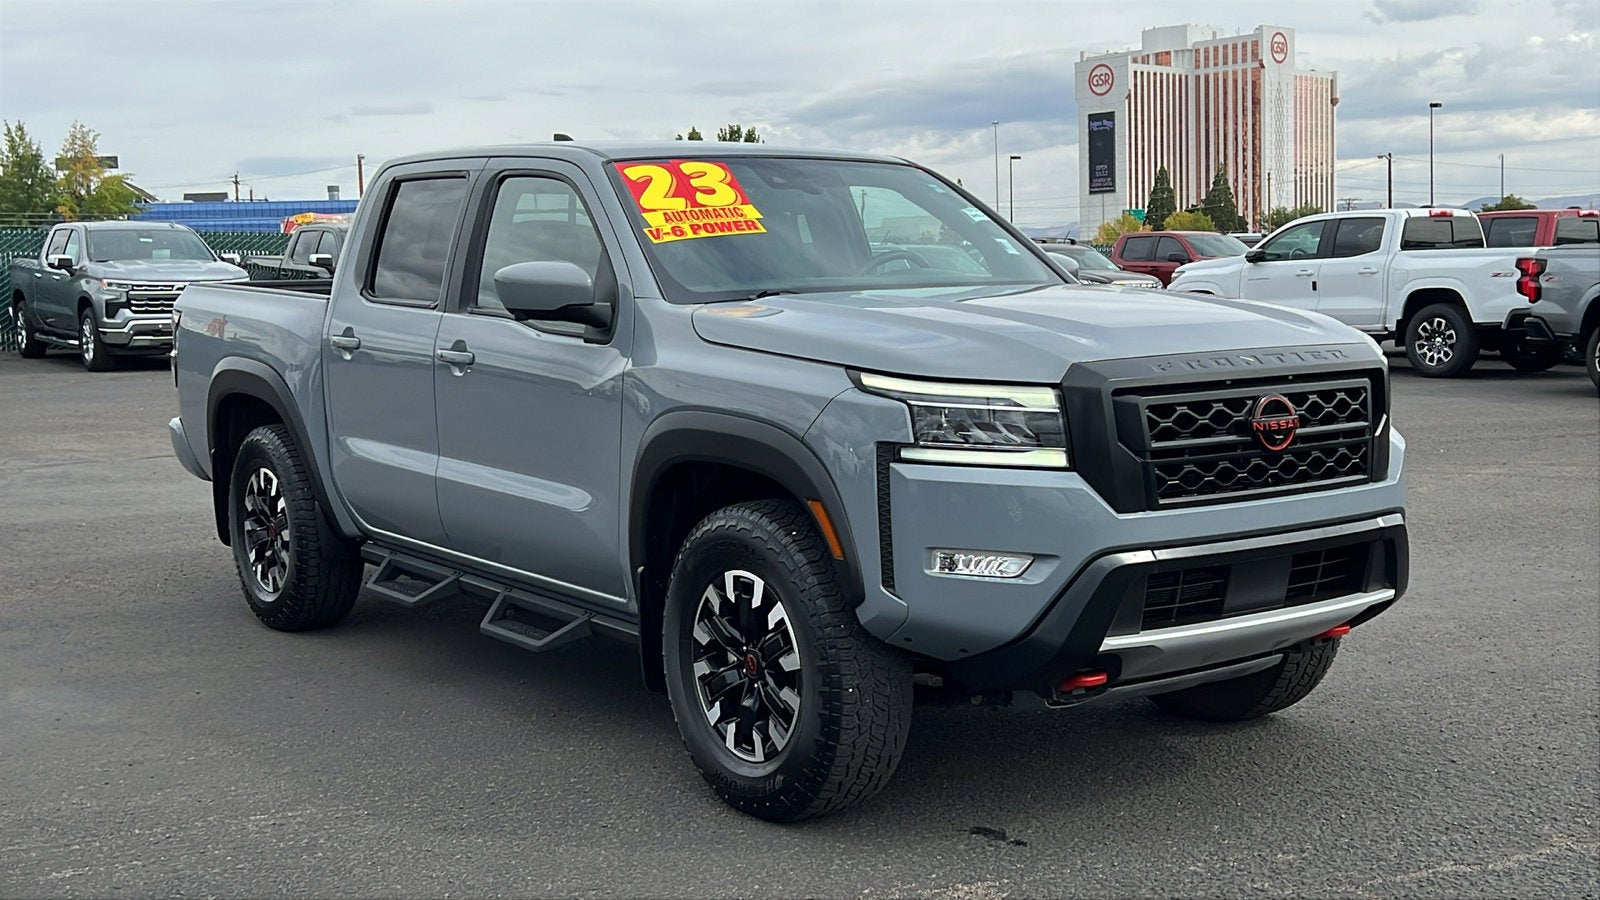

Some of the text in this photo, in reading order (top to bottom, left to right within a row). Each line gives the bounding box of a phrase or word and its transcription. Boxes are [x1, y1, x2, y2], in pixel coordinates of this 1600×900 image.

[1273, 41, 1286, 54] GSR
[1091, 72, 1111, 87] GSR
[623, 161, 742, 210] 23
[663, 207, 746, 224] AUTOMATIC
[646, 220, 760, 240] V-6 POWER
[1151, 349, 1349, 373] FRONTIER
